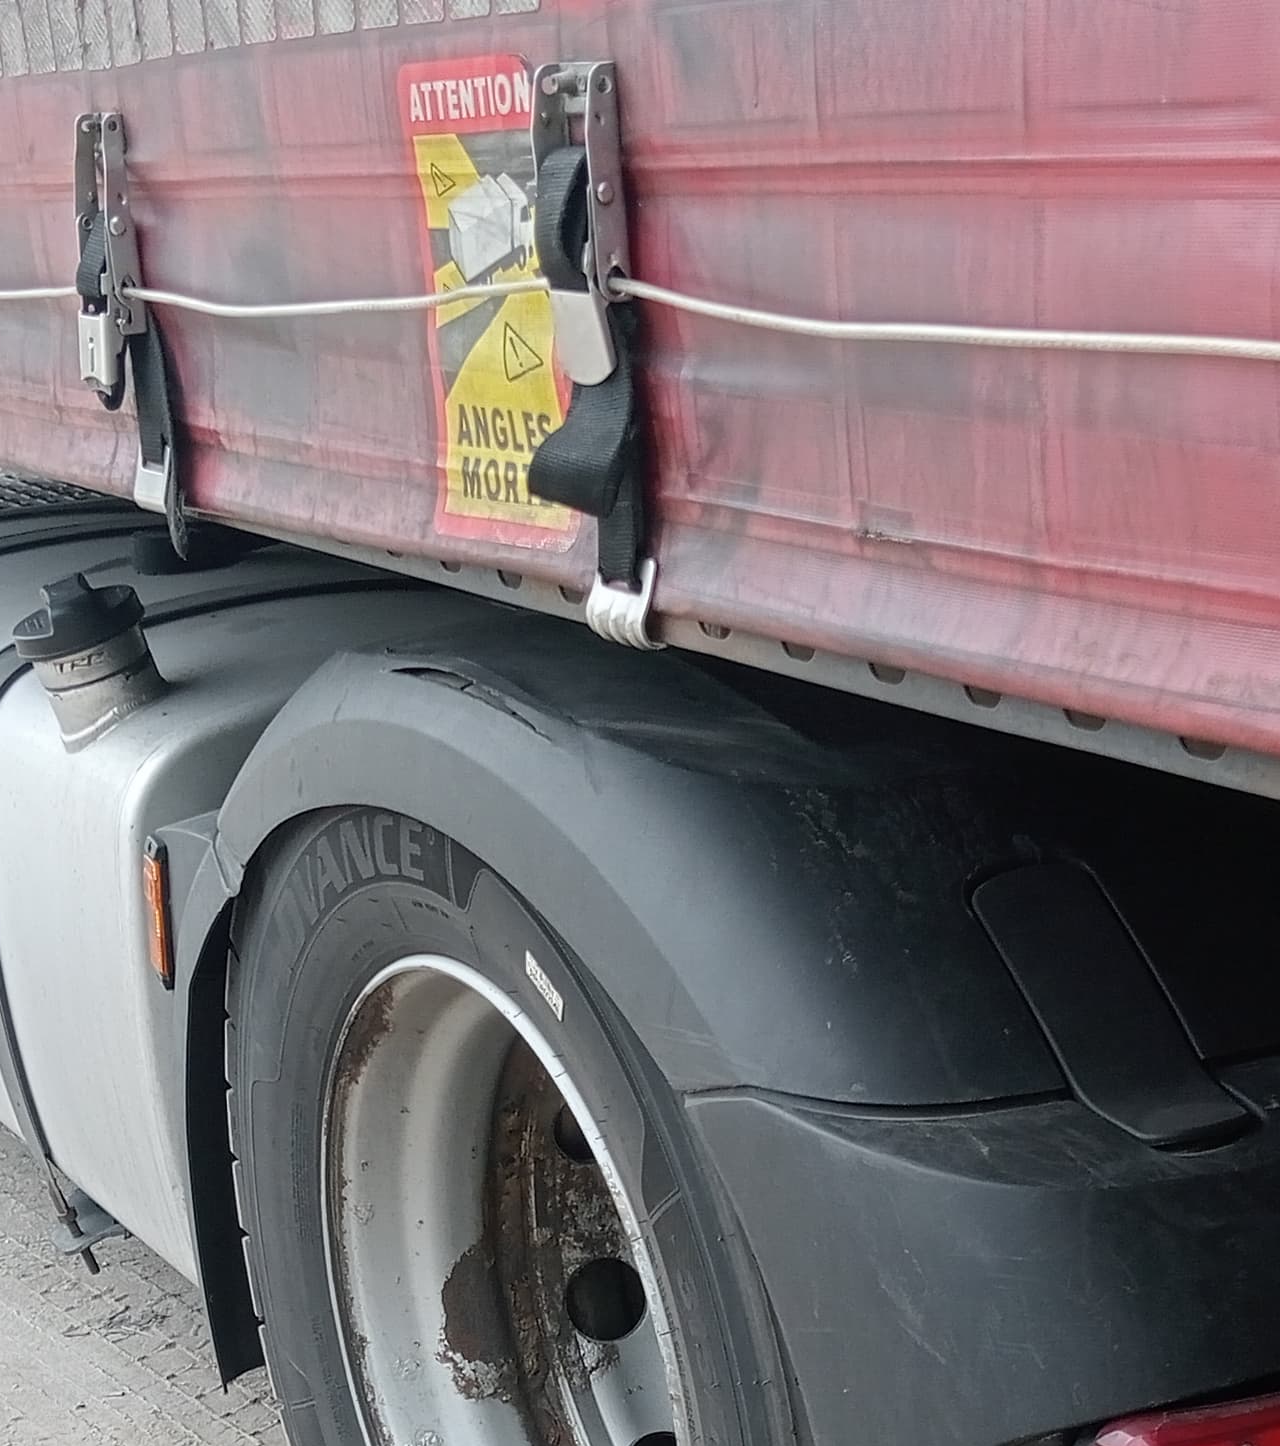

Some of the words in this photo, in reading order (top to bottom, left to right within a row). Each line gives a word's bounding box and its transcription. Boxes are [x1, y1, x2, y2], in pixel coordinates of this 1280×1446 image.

[409, 71, 531, 123] ATTENTION
[457, 403, 552, 453] ANGLES
[462, 456, 553, 507] MOR
